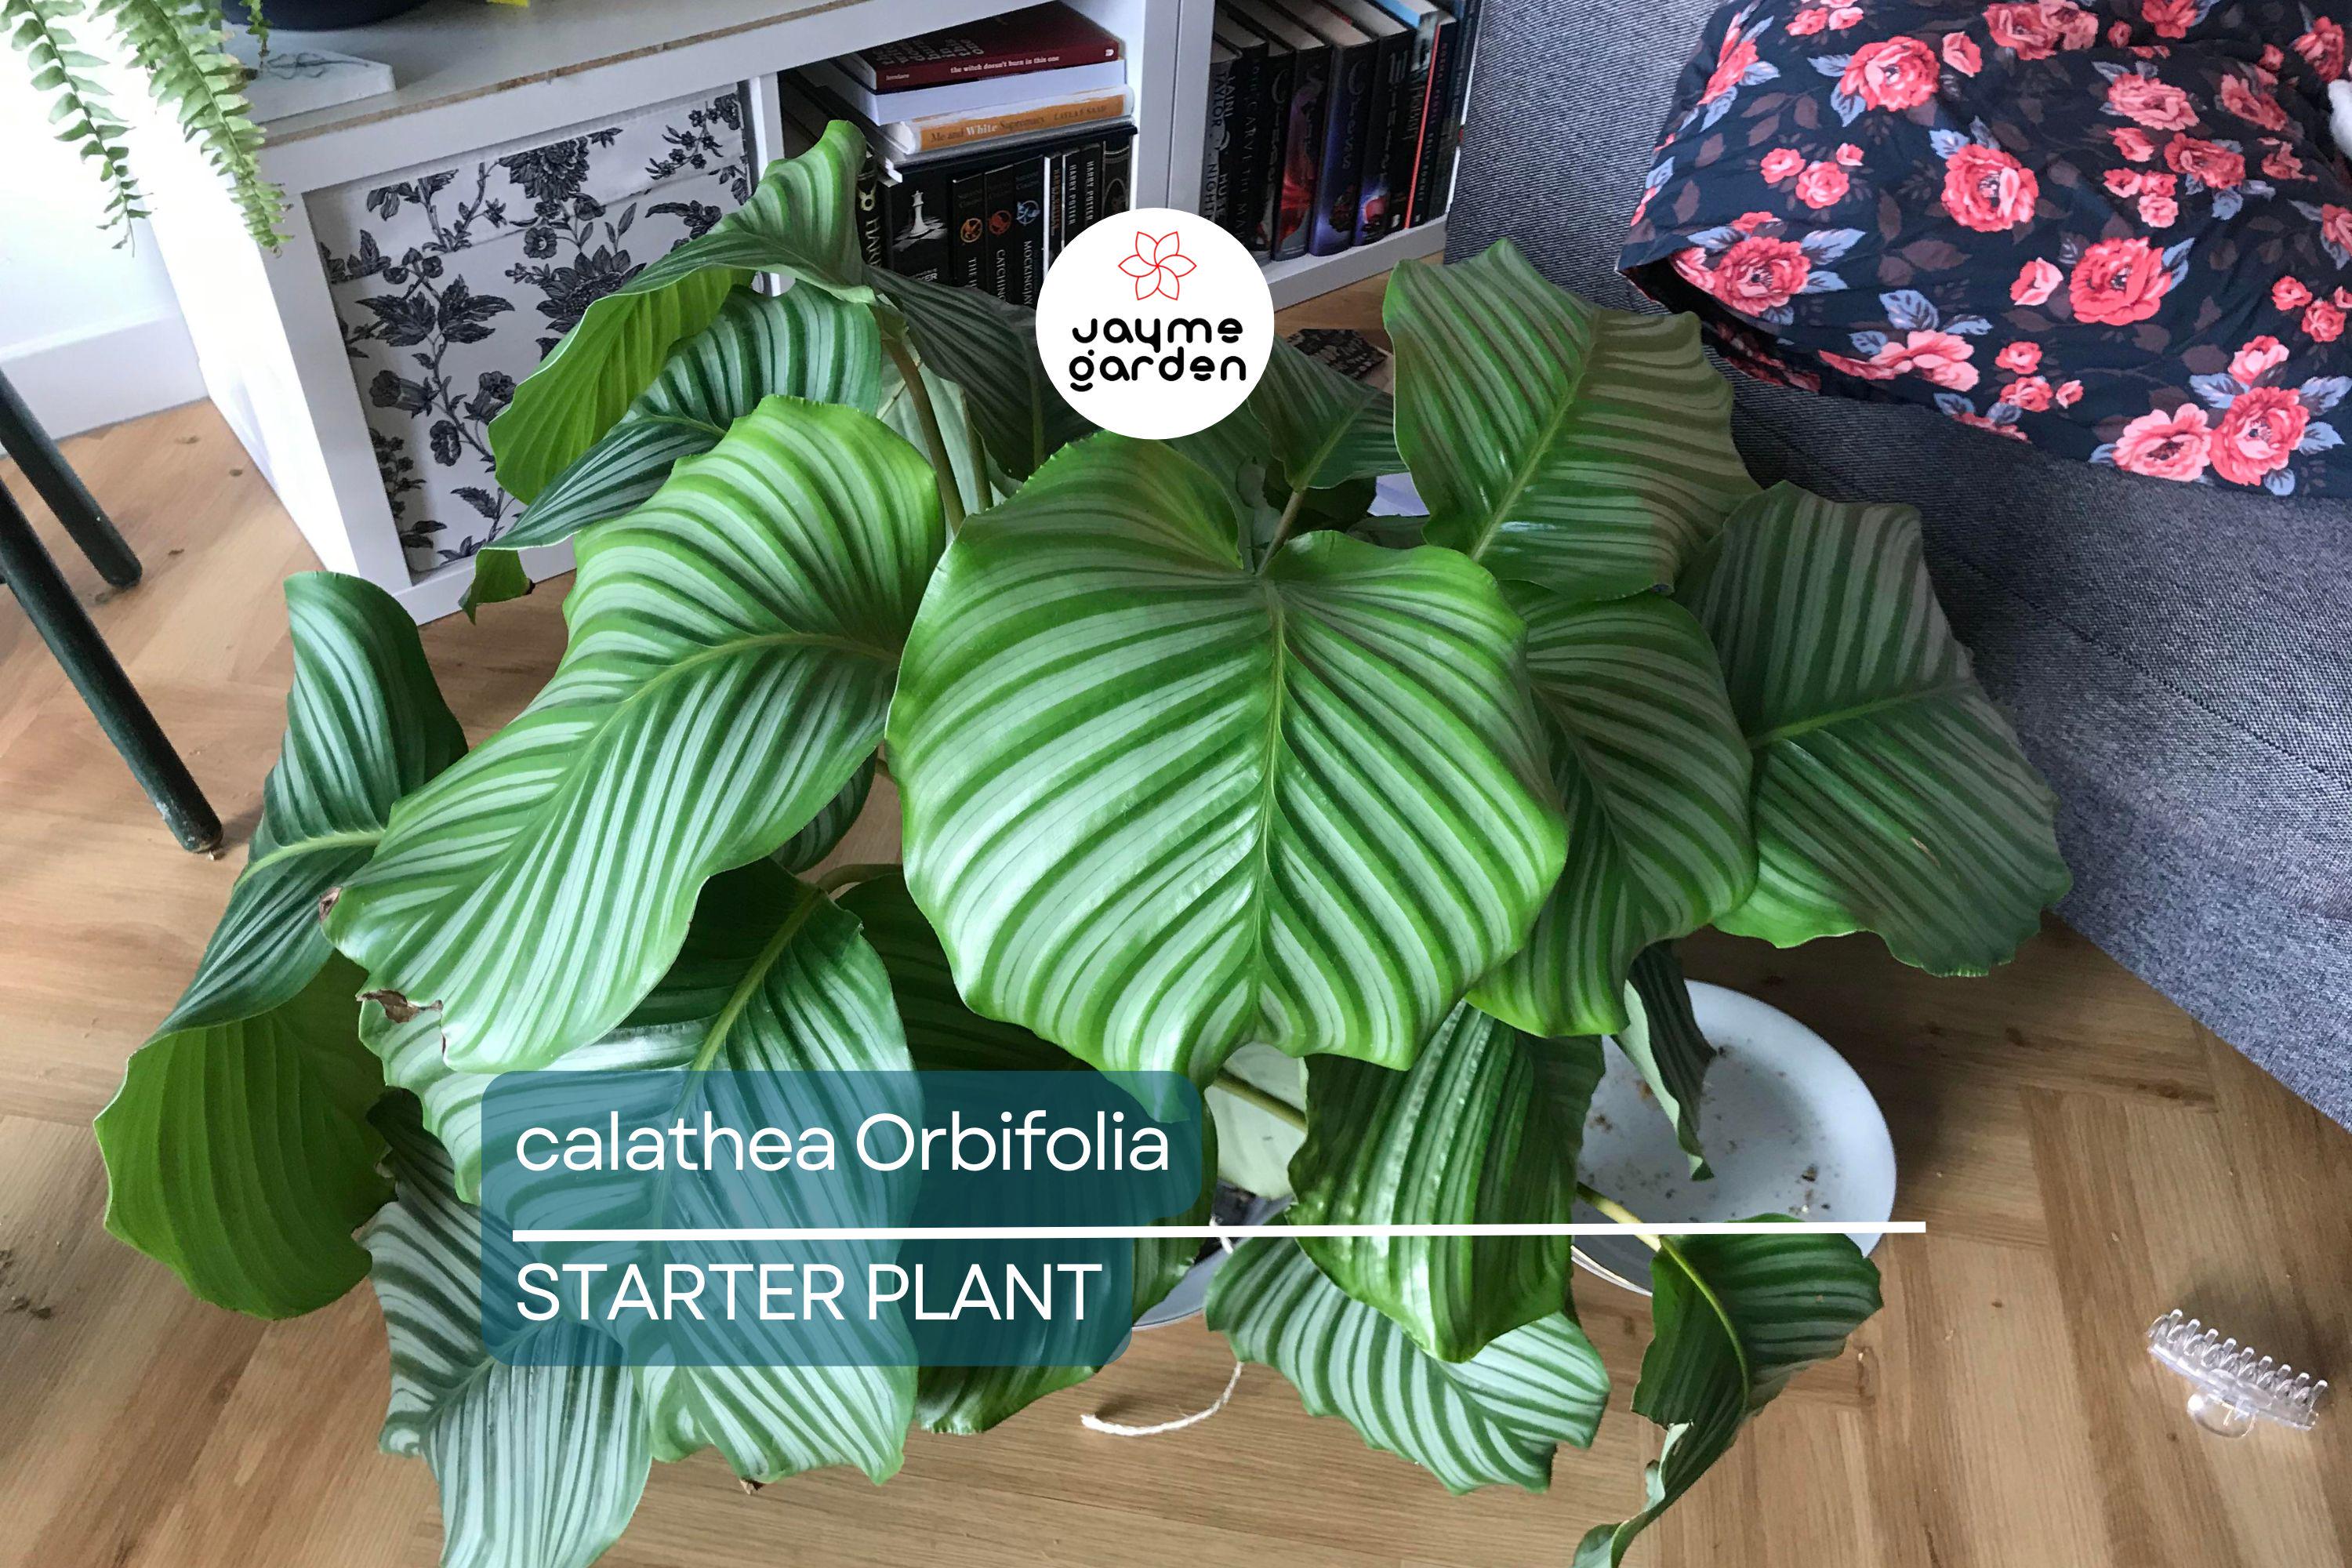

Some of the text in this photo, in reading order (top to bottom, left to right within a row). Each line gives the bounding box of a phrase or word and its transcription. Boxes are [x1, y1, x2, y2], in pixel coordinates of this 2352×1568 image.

[983, 61, 1007, 70] doesn't
[1212, 71, 1225, 126] TAYLOR
[966, 123, 998, 136] White
[1068, 164, 1078, 225] HARRY POTTER
[1085, 161, 1095, 220] HARRY POTTER
[1022, 239, 1033, 305] MOCKINGJAY
